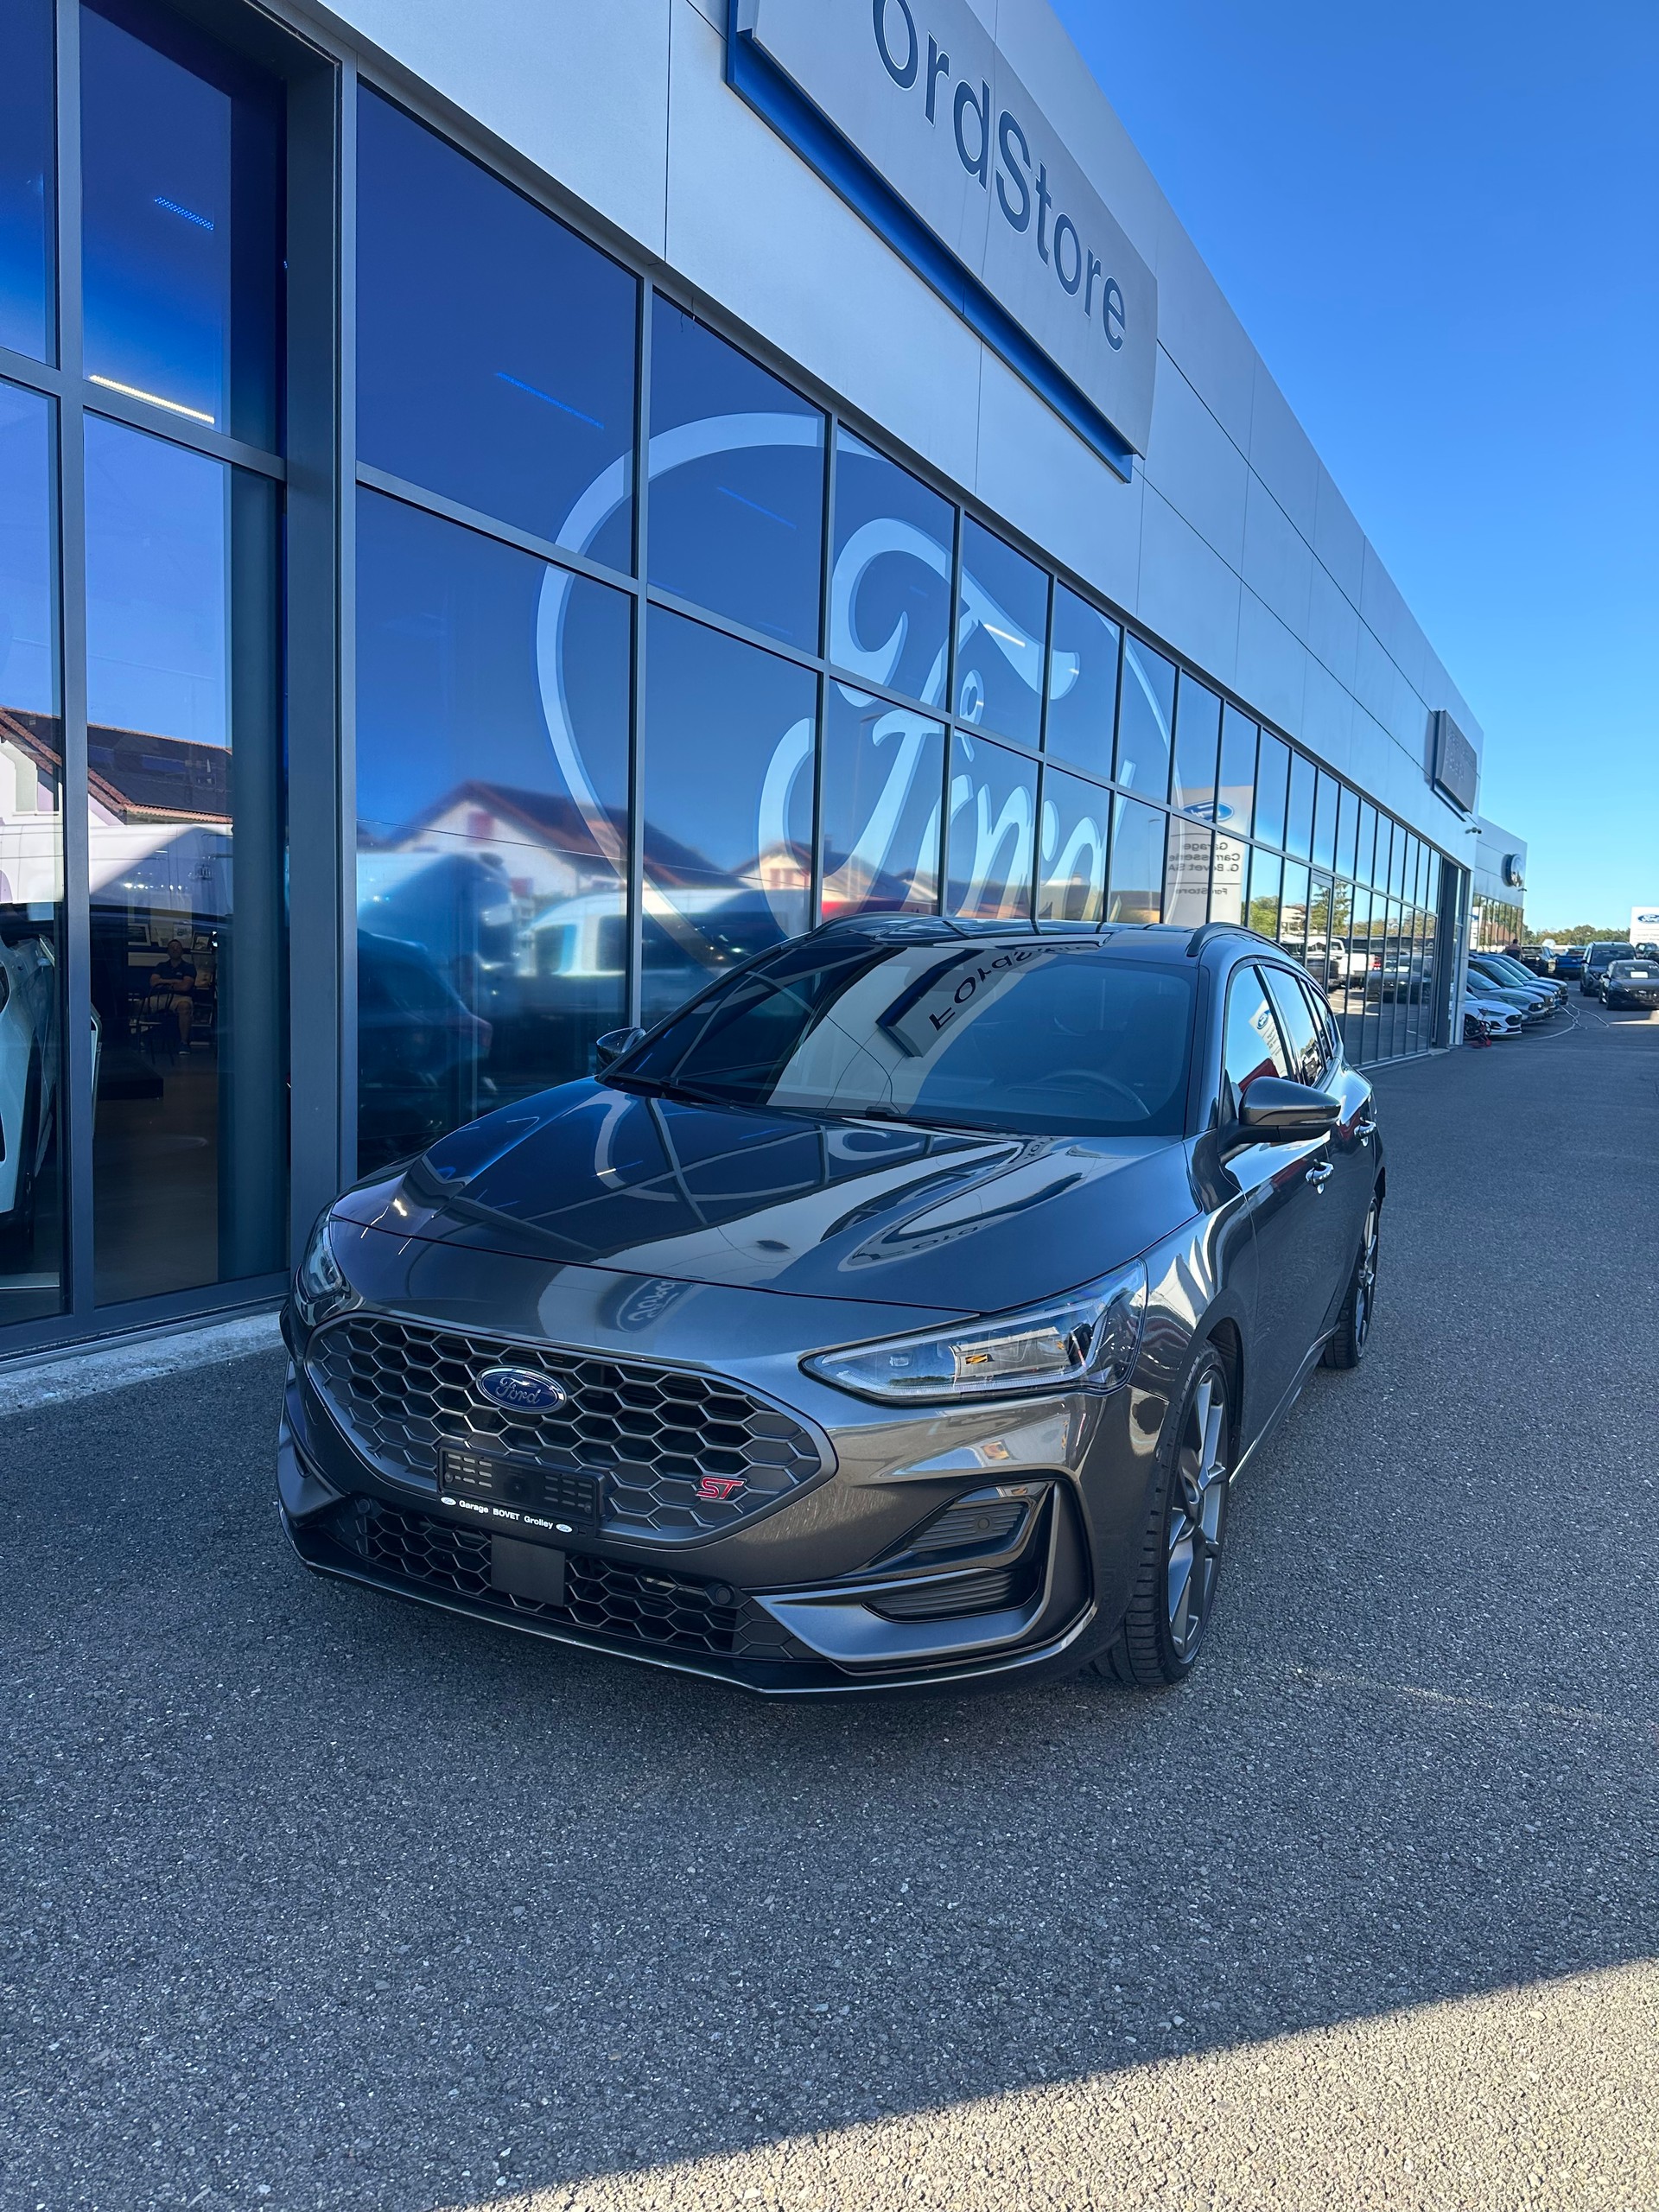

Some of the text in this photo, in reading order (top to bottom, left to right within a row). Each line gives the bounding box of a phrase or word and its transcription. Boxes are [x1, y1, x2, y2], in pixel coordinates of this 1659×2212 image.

[495, 1376, 542, 1404] Ford
[696, 1476, 746, 1500] ST
[459, 1500, 489, 1514] Garage
[493, 1508, 520, 1521] BOVET
[524, 1516, 554, 1529] Grolley
